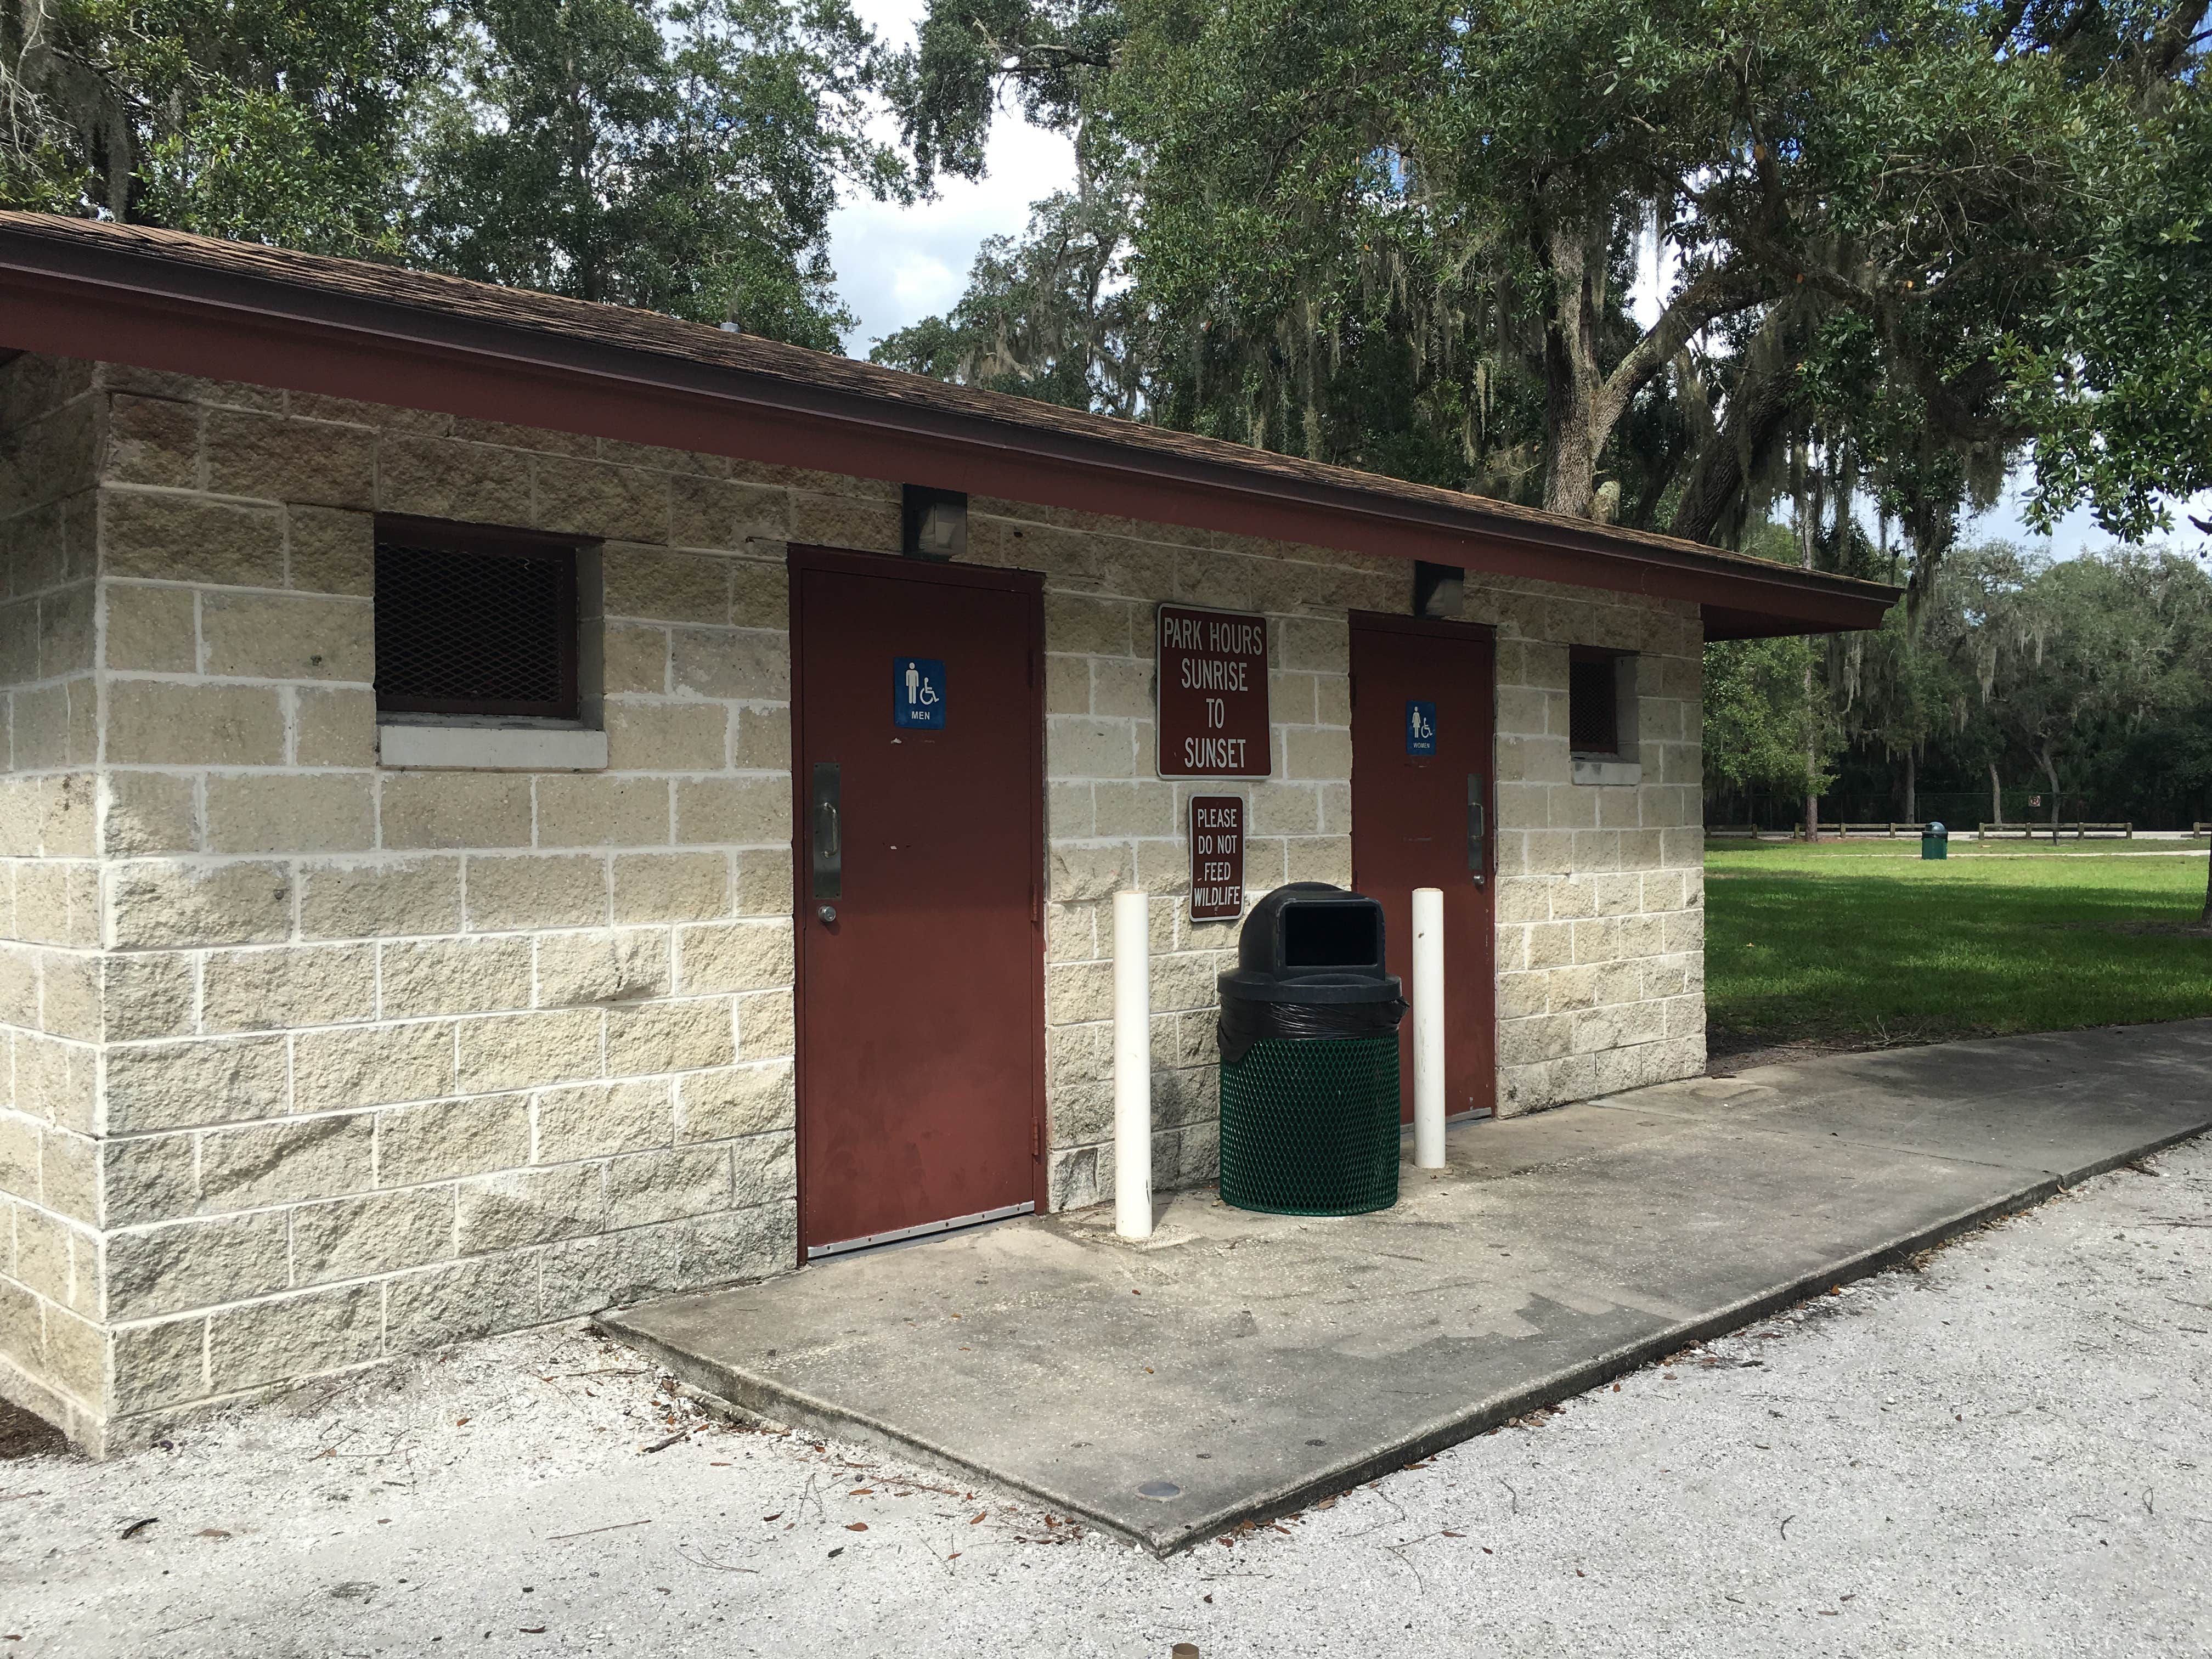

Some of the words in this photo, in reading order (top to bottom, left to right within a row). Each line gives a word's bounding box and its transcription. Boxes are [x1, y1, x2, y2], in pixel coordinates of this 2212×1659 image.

[1164, 618, 1202, 650] PARK
[1210, 622, 1262, 655] HOURS
[1181, 658, 1248, 691] SUNRISE
[911, 711, 930, 720] MEN
[1206, 698, 1224, 729] TO
[1184, 737, 1246, 768] SUNSET
[1198, 809, 1237, 828] PLEASE
[1198, 835, 1212, 854] DO
[1217, 835, 1237, 854] NOT
[1204, 862, 1231, 882] FEED
[1194, 886, 1240, 907] WILDLIFE
